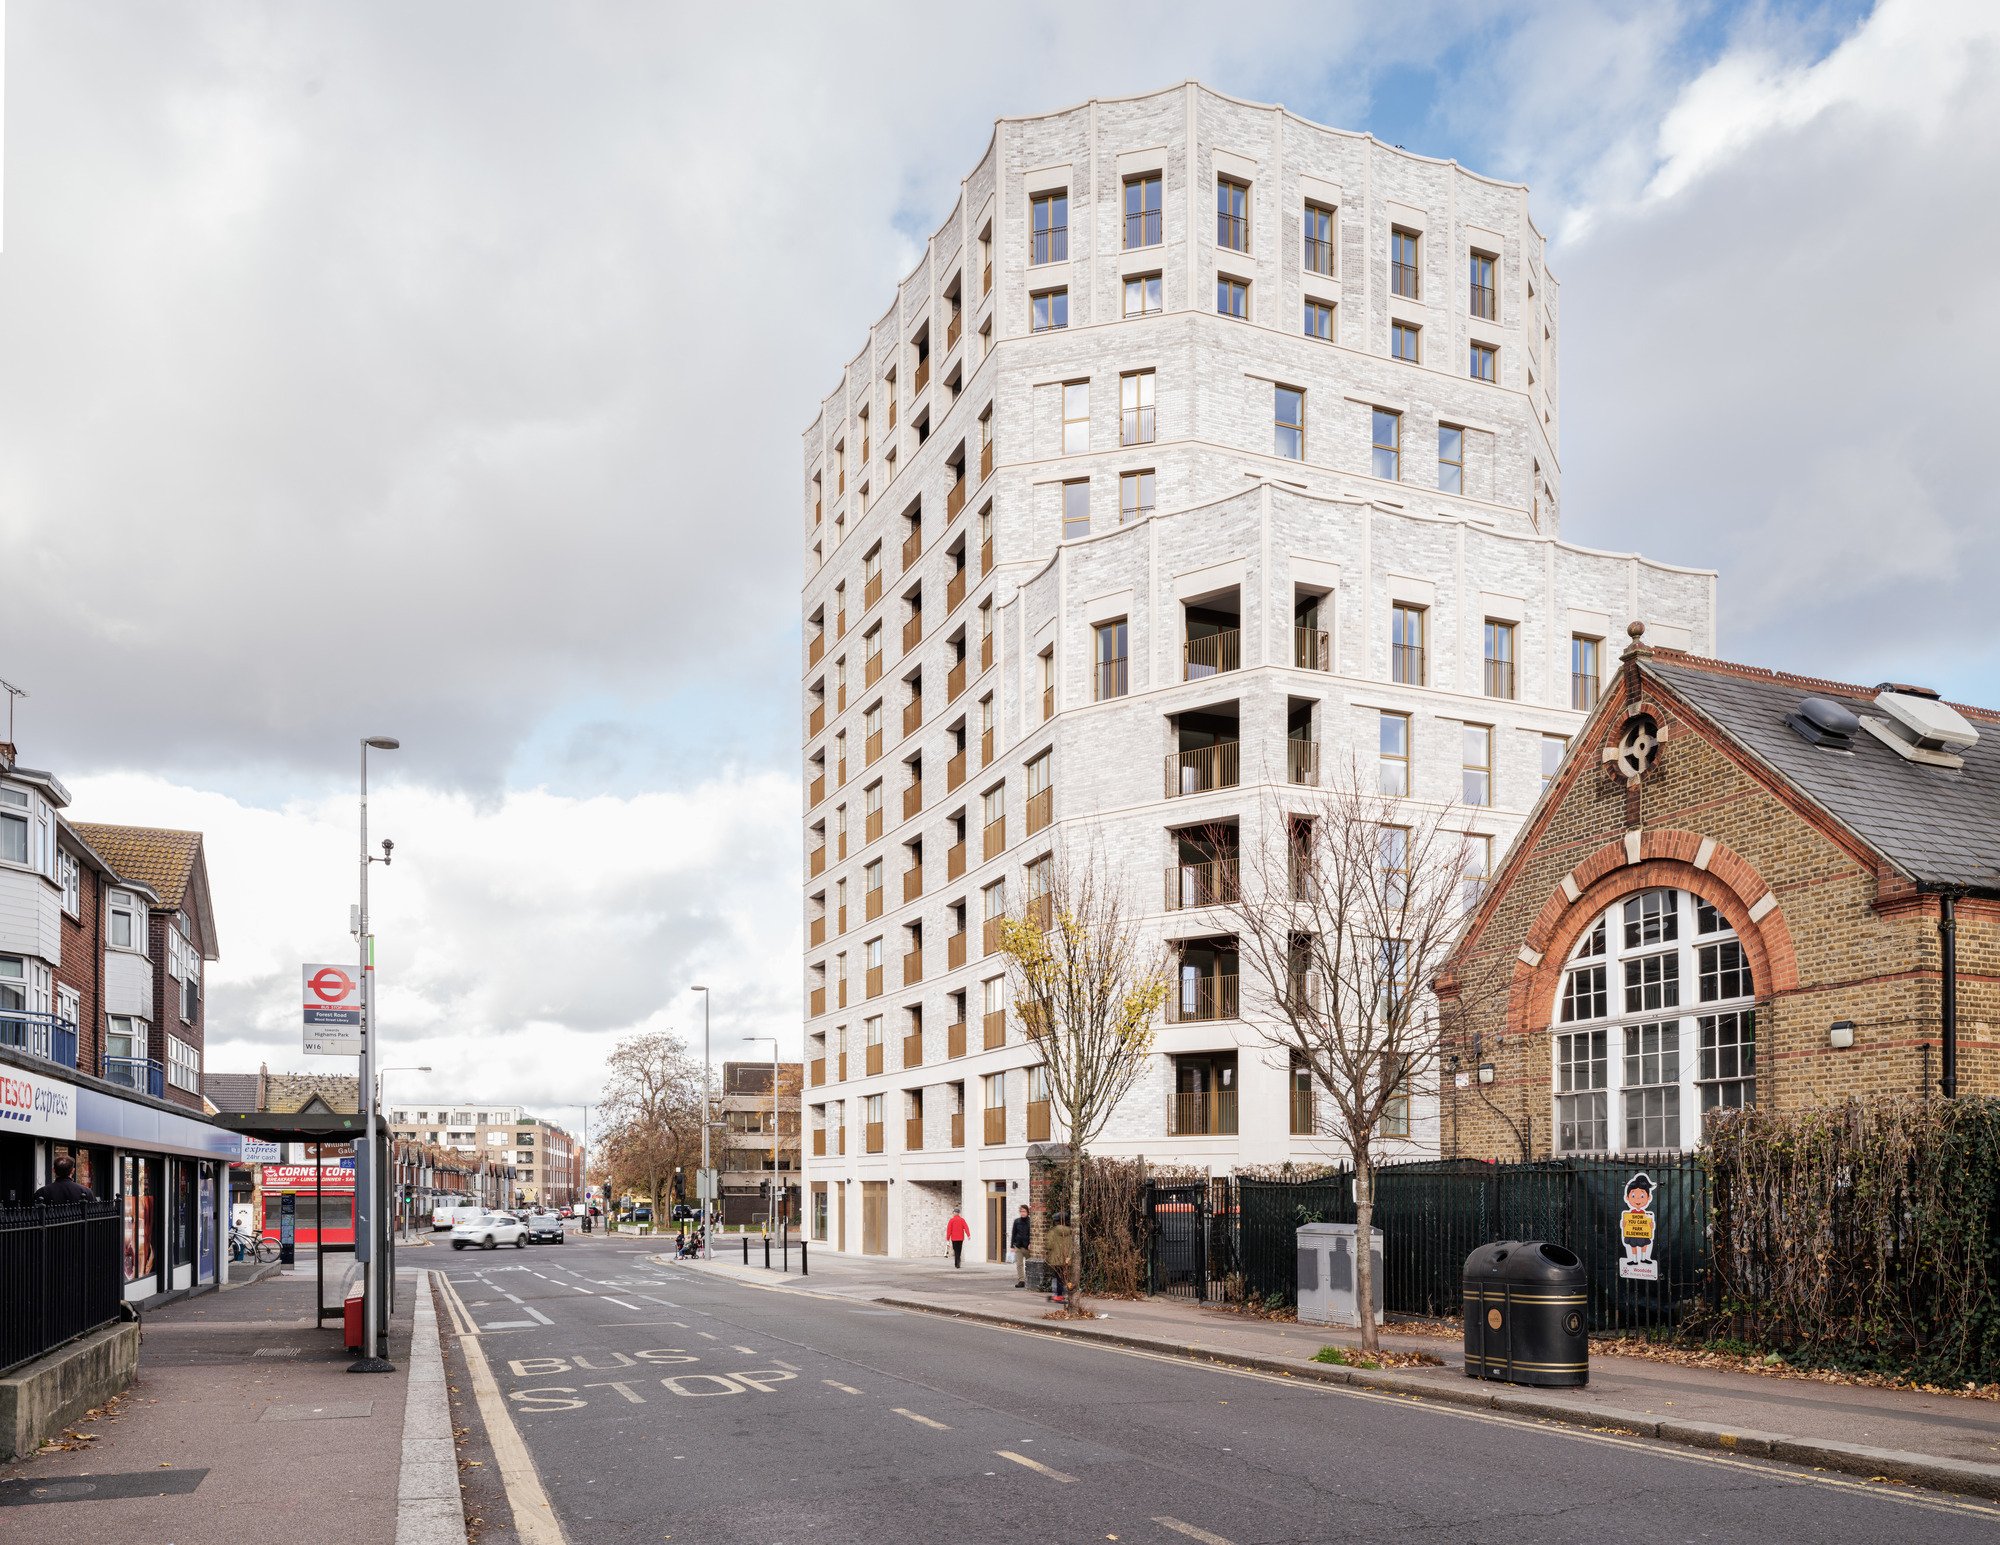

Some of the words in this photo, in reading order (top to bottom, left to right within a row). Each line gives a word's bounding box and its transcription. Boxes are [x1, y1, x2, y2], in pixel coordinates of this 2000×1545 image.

[35, 1087, 68, 1123] express
[244, 1146, 278, 1154] express
[508, 1349, 701, 1377] BUS
[508, 1370, 799, 1413] STOP
